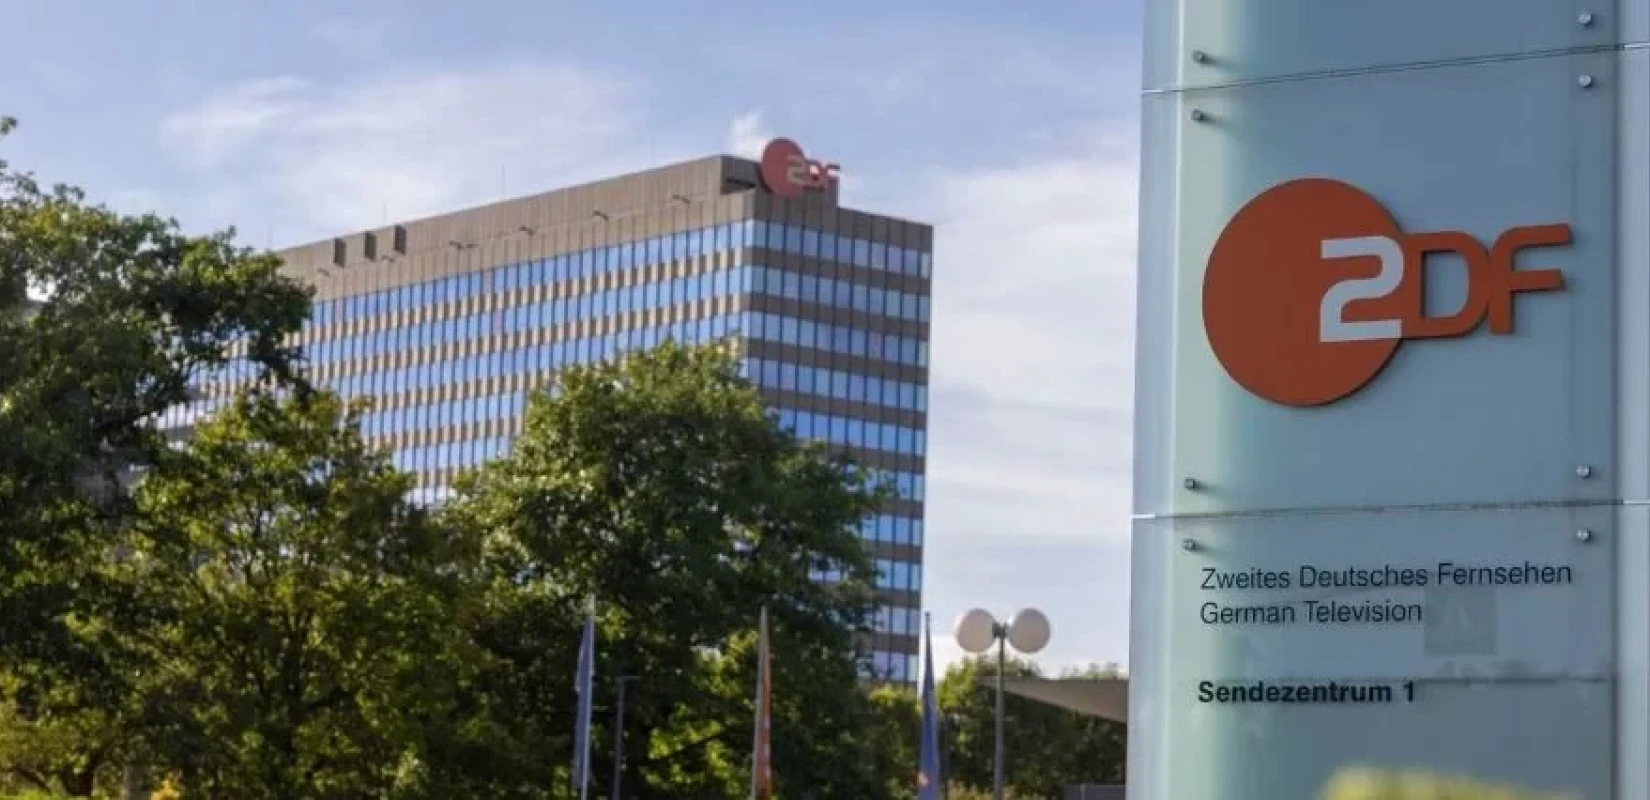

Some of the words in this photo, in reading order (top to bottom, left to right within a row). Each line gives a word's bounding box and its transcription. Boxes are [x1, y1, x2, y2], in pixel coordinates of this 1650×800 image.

[1201, 566, 1291, 590] Zweites
[1300, 564, 1429, 588] Deutsches
[1438, 560, 1572, 586] Fernsehen
[1201, 601, 1295, 625] German
[1305, 598, 1422, 624] Television
[1198, 681, 1392, 703] Sendezentrum
[1403, 681, 1416, 702] 1
